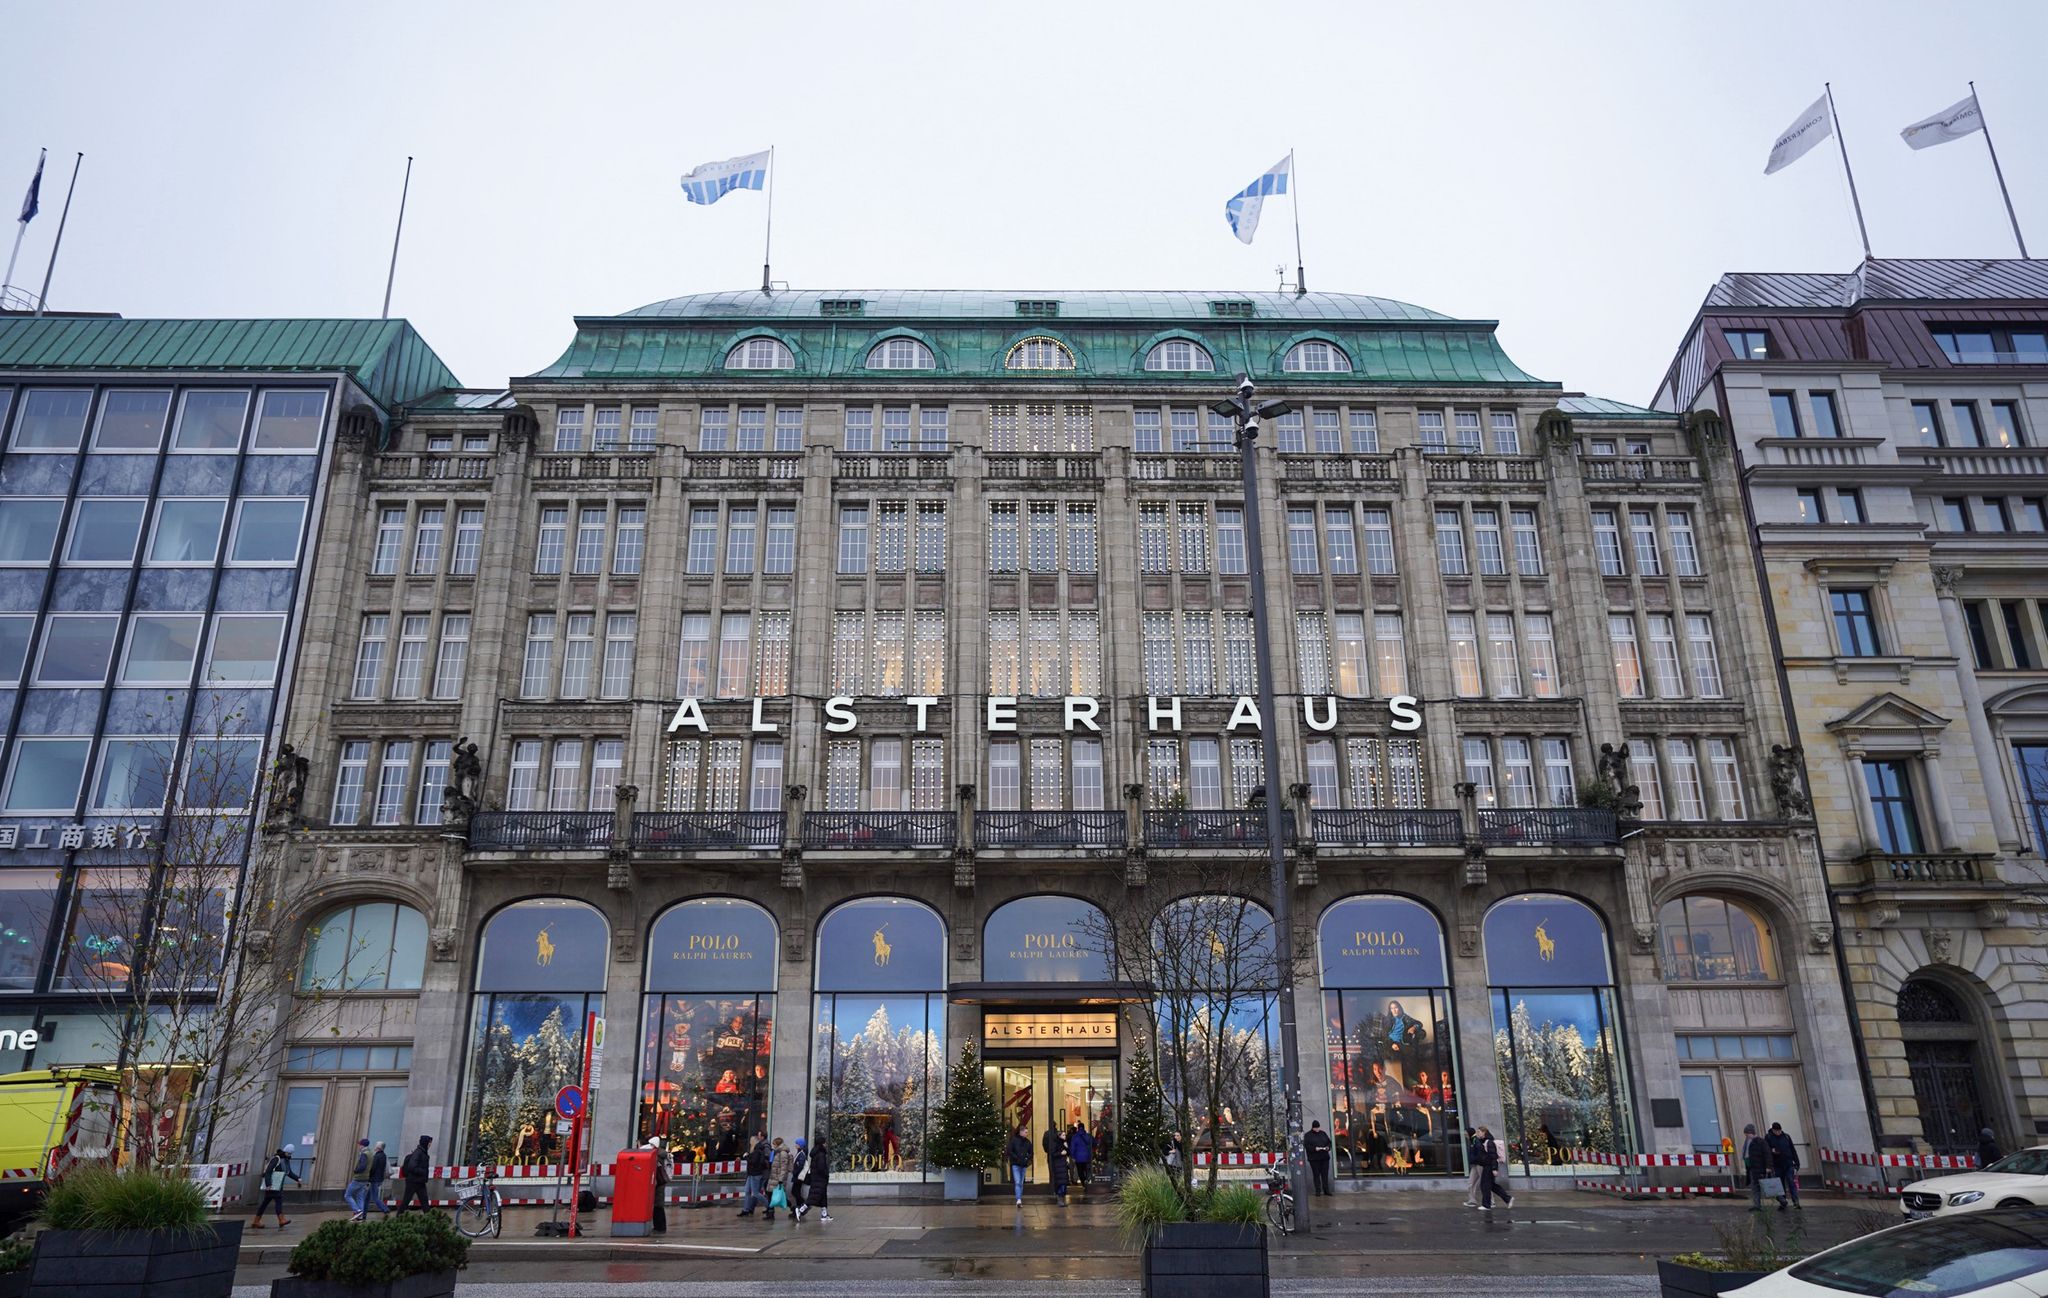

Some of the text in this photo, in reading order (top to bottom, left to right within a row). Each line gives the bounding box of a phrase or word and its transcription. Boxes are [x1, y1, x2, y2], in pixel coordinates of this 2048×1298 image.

[667, 695, 1422, 733] ALSTERHAUS
[0, 824, 151, 849] 国工商银行
[689, 935, 739, 950] POLO
[1025, 934, 1074, 949] POLO
[1355, 931, 1405, 946] POLO
[673, 952, 753, 960] RALPH LAUREN
[1009, 951, 1089, 959] RALPH LAUREN
[1342, 948, 1420, 956] RALPH LAUREN
[990, 1025, 1112, 1035] ALSTERHAUS
[850, 1153, 904, 1170] POLO
